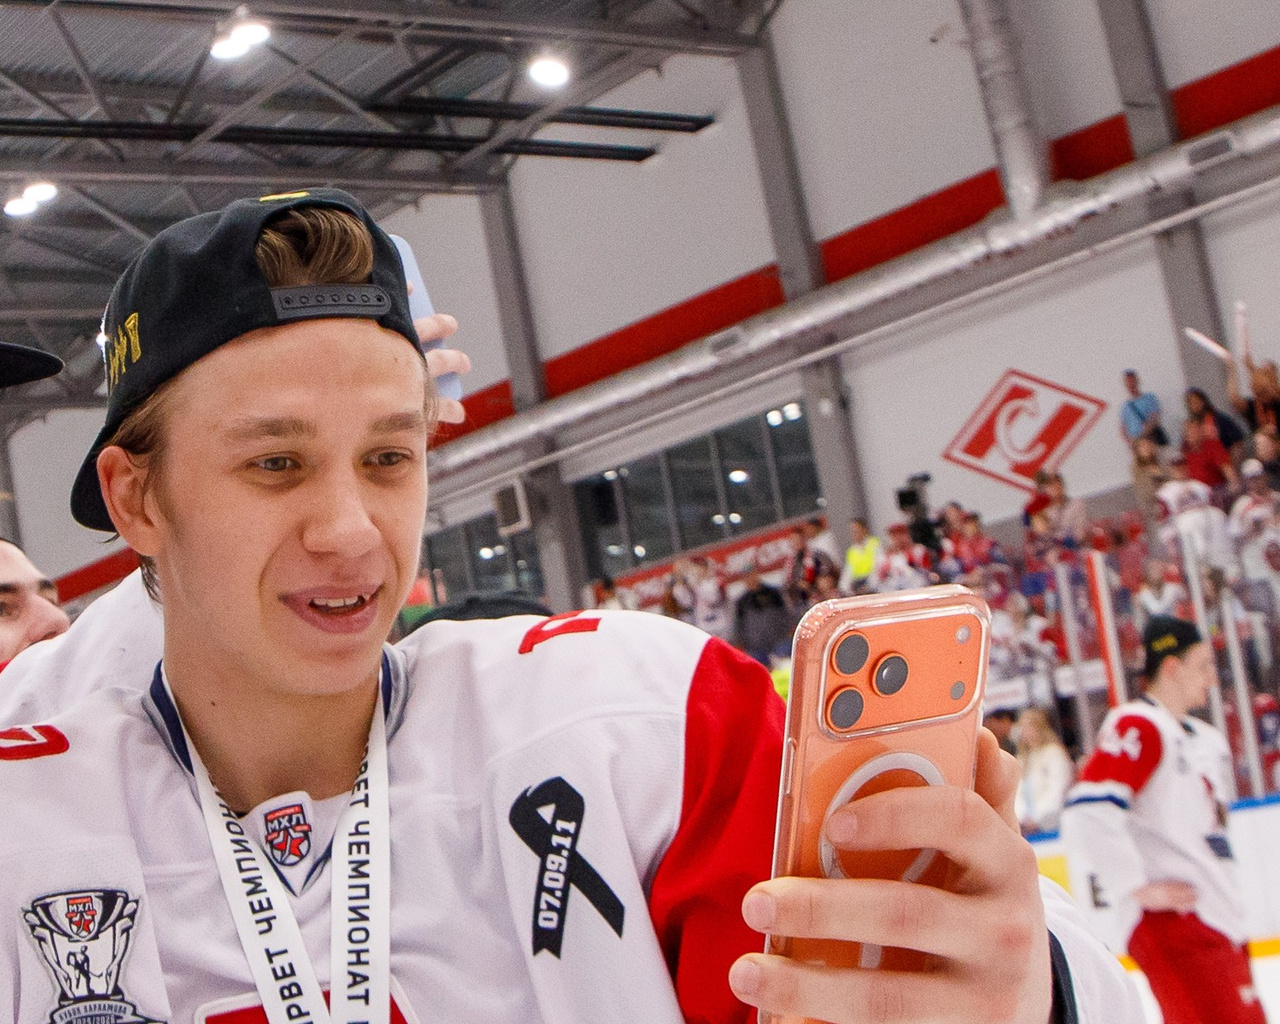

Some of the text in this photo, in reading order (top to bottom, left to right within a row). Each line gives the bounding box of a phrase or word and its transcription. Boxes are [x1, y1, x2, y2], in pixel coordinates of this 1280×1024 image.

[267, 814, 304, 833] МХЛ
[537, 819, 577, 930] 07.09.11
[69, 902, 94, 913] МХЛ
[346, 820, 370, 1006] ЧЕМПИОНАТ
